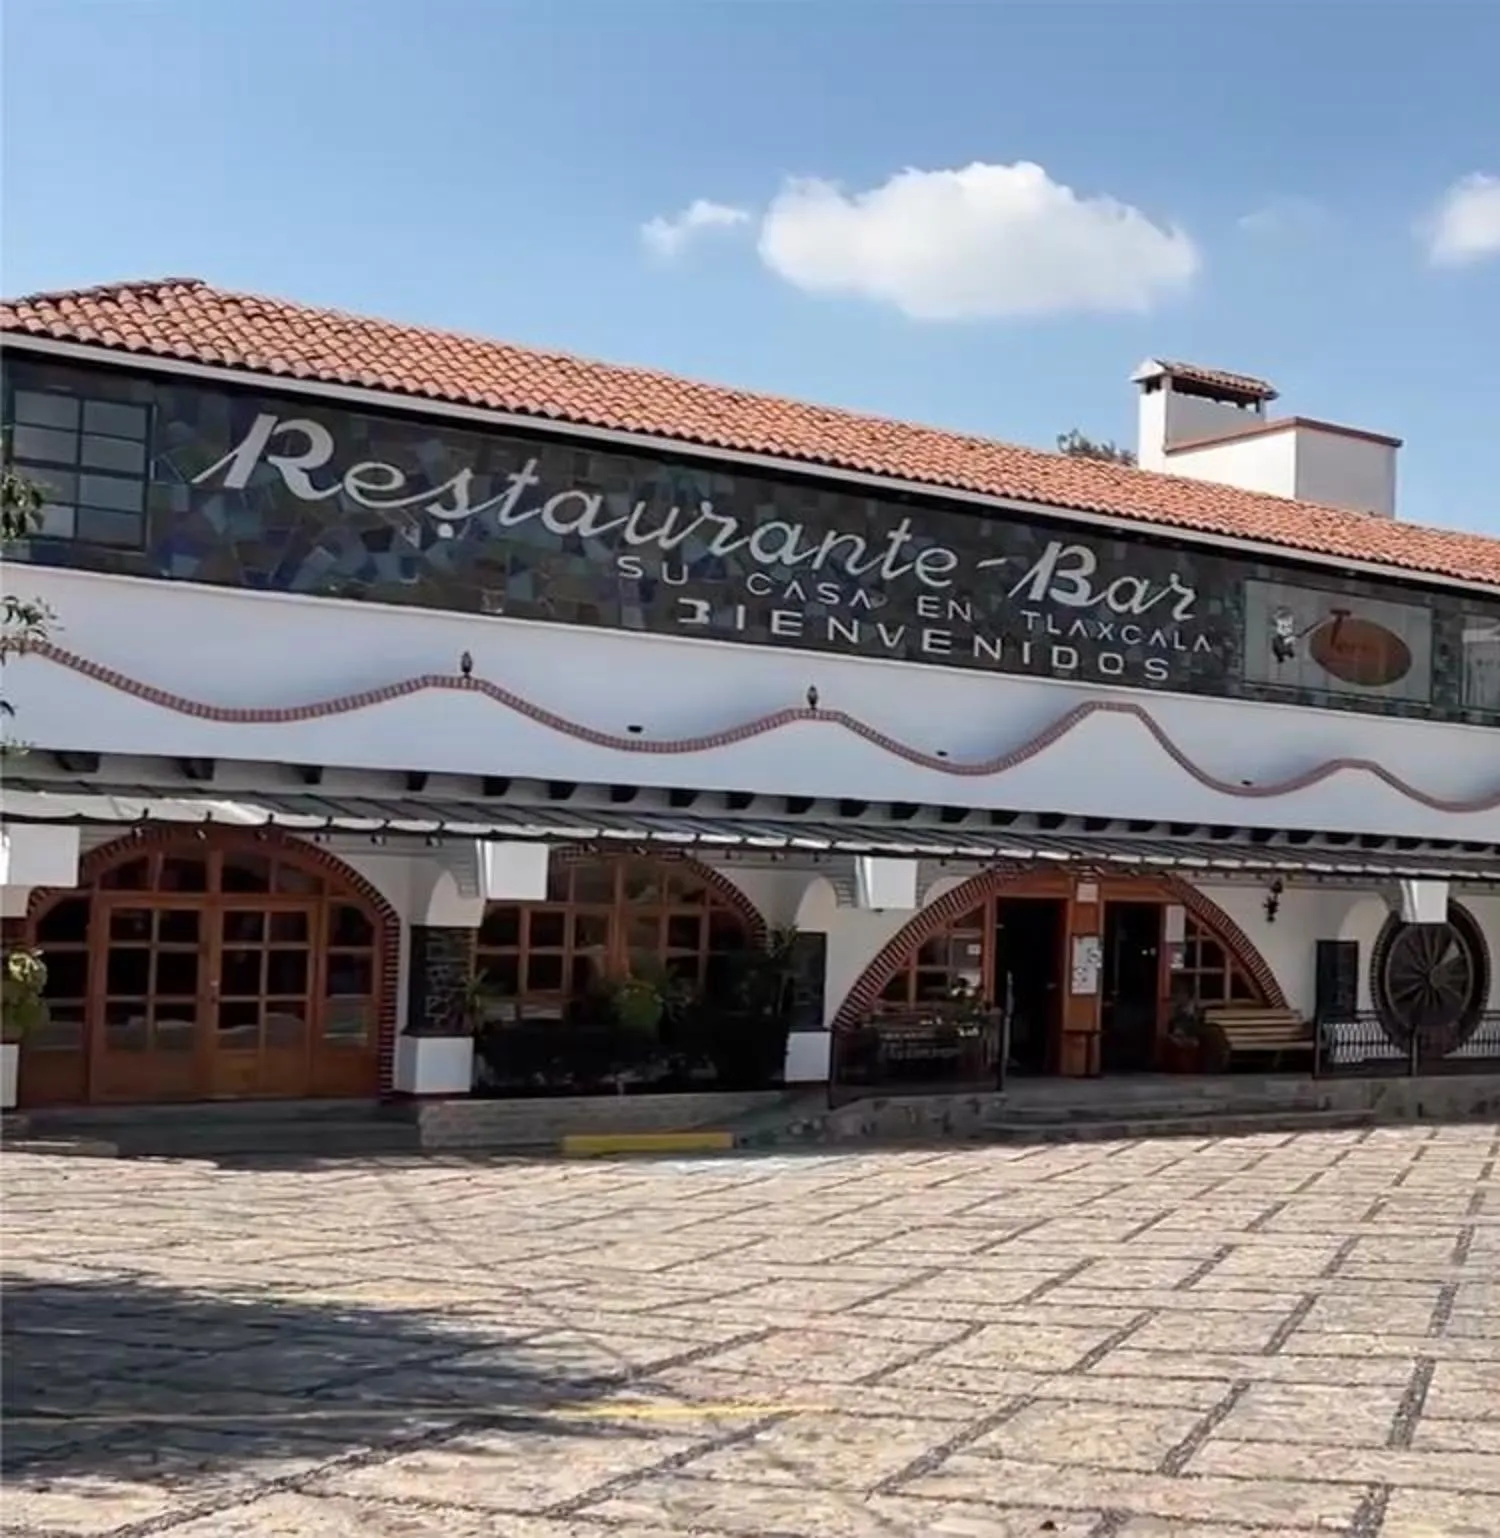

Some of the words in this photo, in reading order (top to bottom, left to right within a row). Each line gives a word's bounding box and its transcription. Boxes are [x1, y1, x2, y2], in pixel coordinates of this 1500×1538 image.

[617, 555, 688, 584] SU
[746, 573, 872, 609] CASA
[917, 595, 972, 623] EN
[1021, 610, 1212, 652] TLAXCALA
